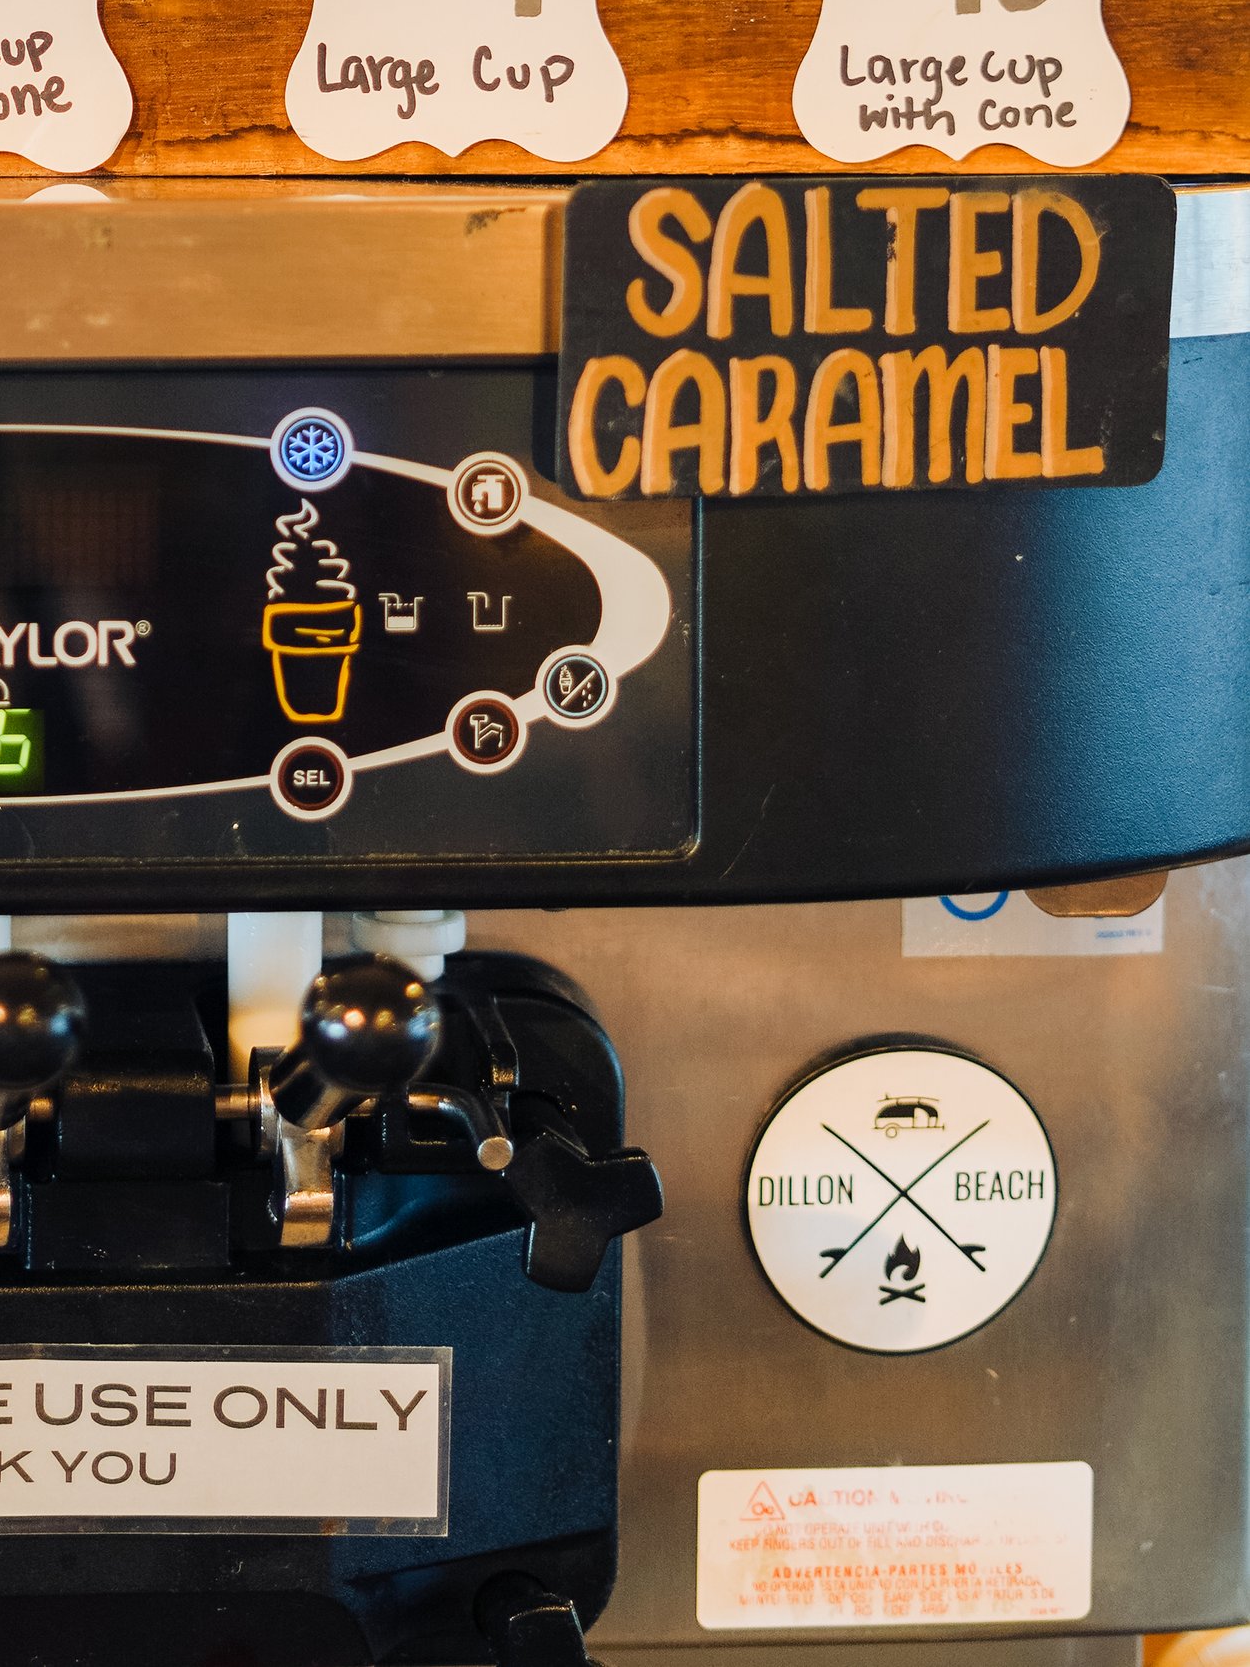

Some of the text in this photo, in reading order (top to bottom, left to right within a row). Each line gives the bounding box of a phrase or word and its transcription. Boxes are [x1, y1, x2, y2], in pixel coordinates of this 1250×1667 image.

[317, 43, 440, 120] Large
[840, 45, 968, 103] Large
[858, 93, 956, 136] with
[626, 182, 1101, 339] SALTED
[568, 344, 1105, 498] CARAMEL
[292, 769, 331, 786] SEL
[758, 1170, 1045, 1207] DILLON BEACH
[35, 1381, 193, 1428] USE
[212, 1385, 429, 1432] ONLY
[51, 1450, 178, 1486] YOU
